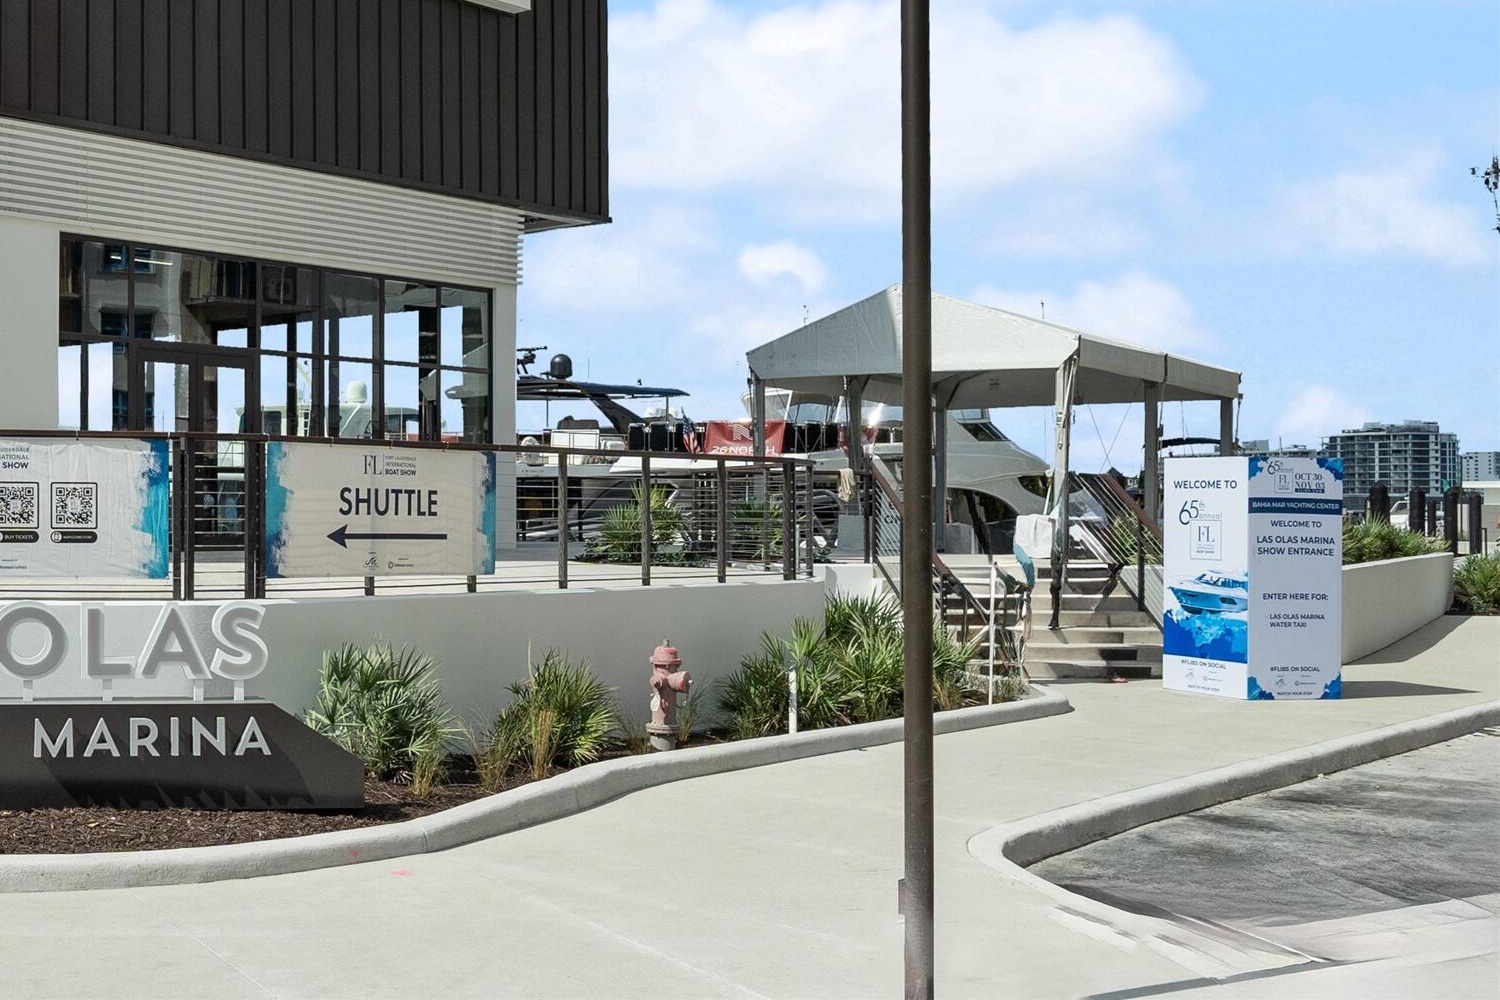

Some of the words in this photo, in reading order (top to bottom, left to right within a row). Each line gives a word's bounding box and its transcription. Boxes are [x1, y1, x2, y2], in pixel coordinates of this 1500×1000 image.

[362, 455, 383, 475] FL
[1295, 473, 1311, 481] OCT
[1312, 473, 1323, 481] 30
[1174, 480, 1221, 489] WELCOME
[1224, 480, 1238, 489] TO
[339, 487, 438, 517] SHUTTLE
[1270, 520, 1310, 528] WELCOME
[1311, 520, 1323, 528] TO
[1198, 526, 1216, 543] FL
[1274, 536, 1299, 544] OLAS
[1300, 536, 1336, 545] MARINA
[1257, 547, 1286, 555] SHOW
[1287, 547, 1335, 557] ENTRANCE
[1311, 593, 1329, 601] FOR:
[33, 716, 272, 758] MARINA
